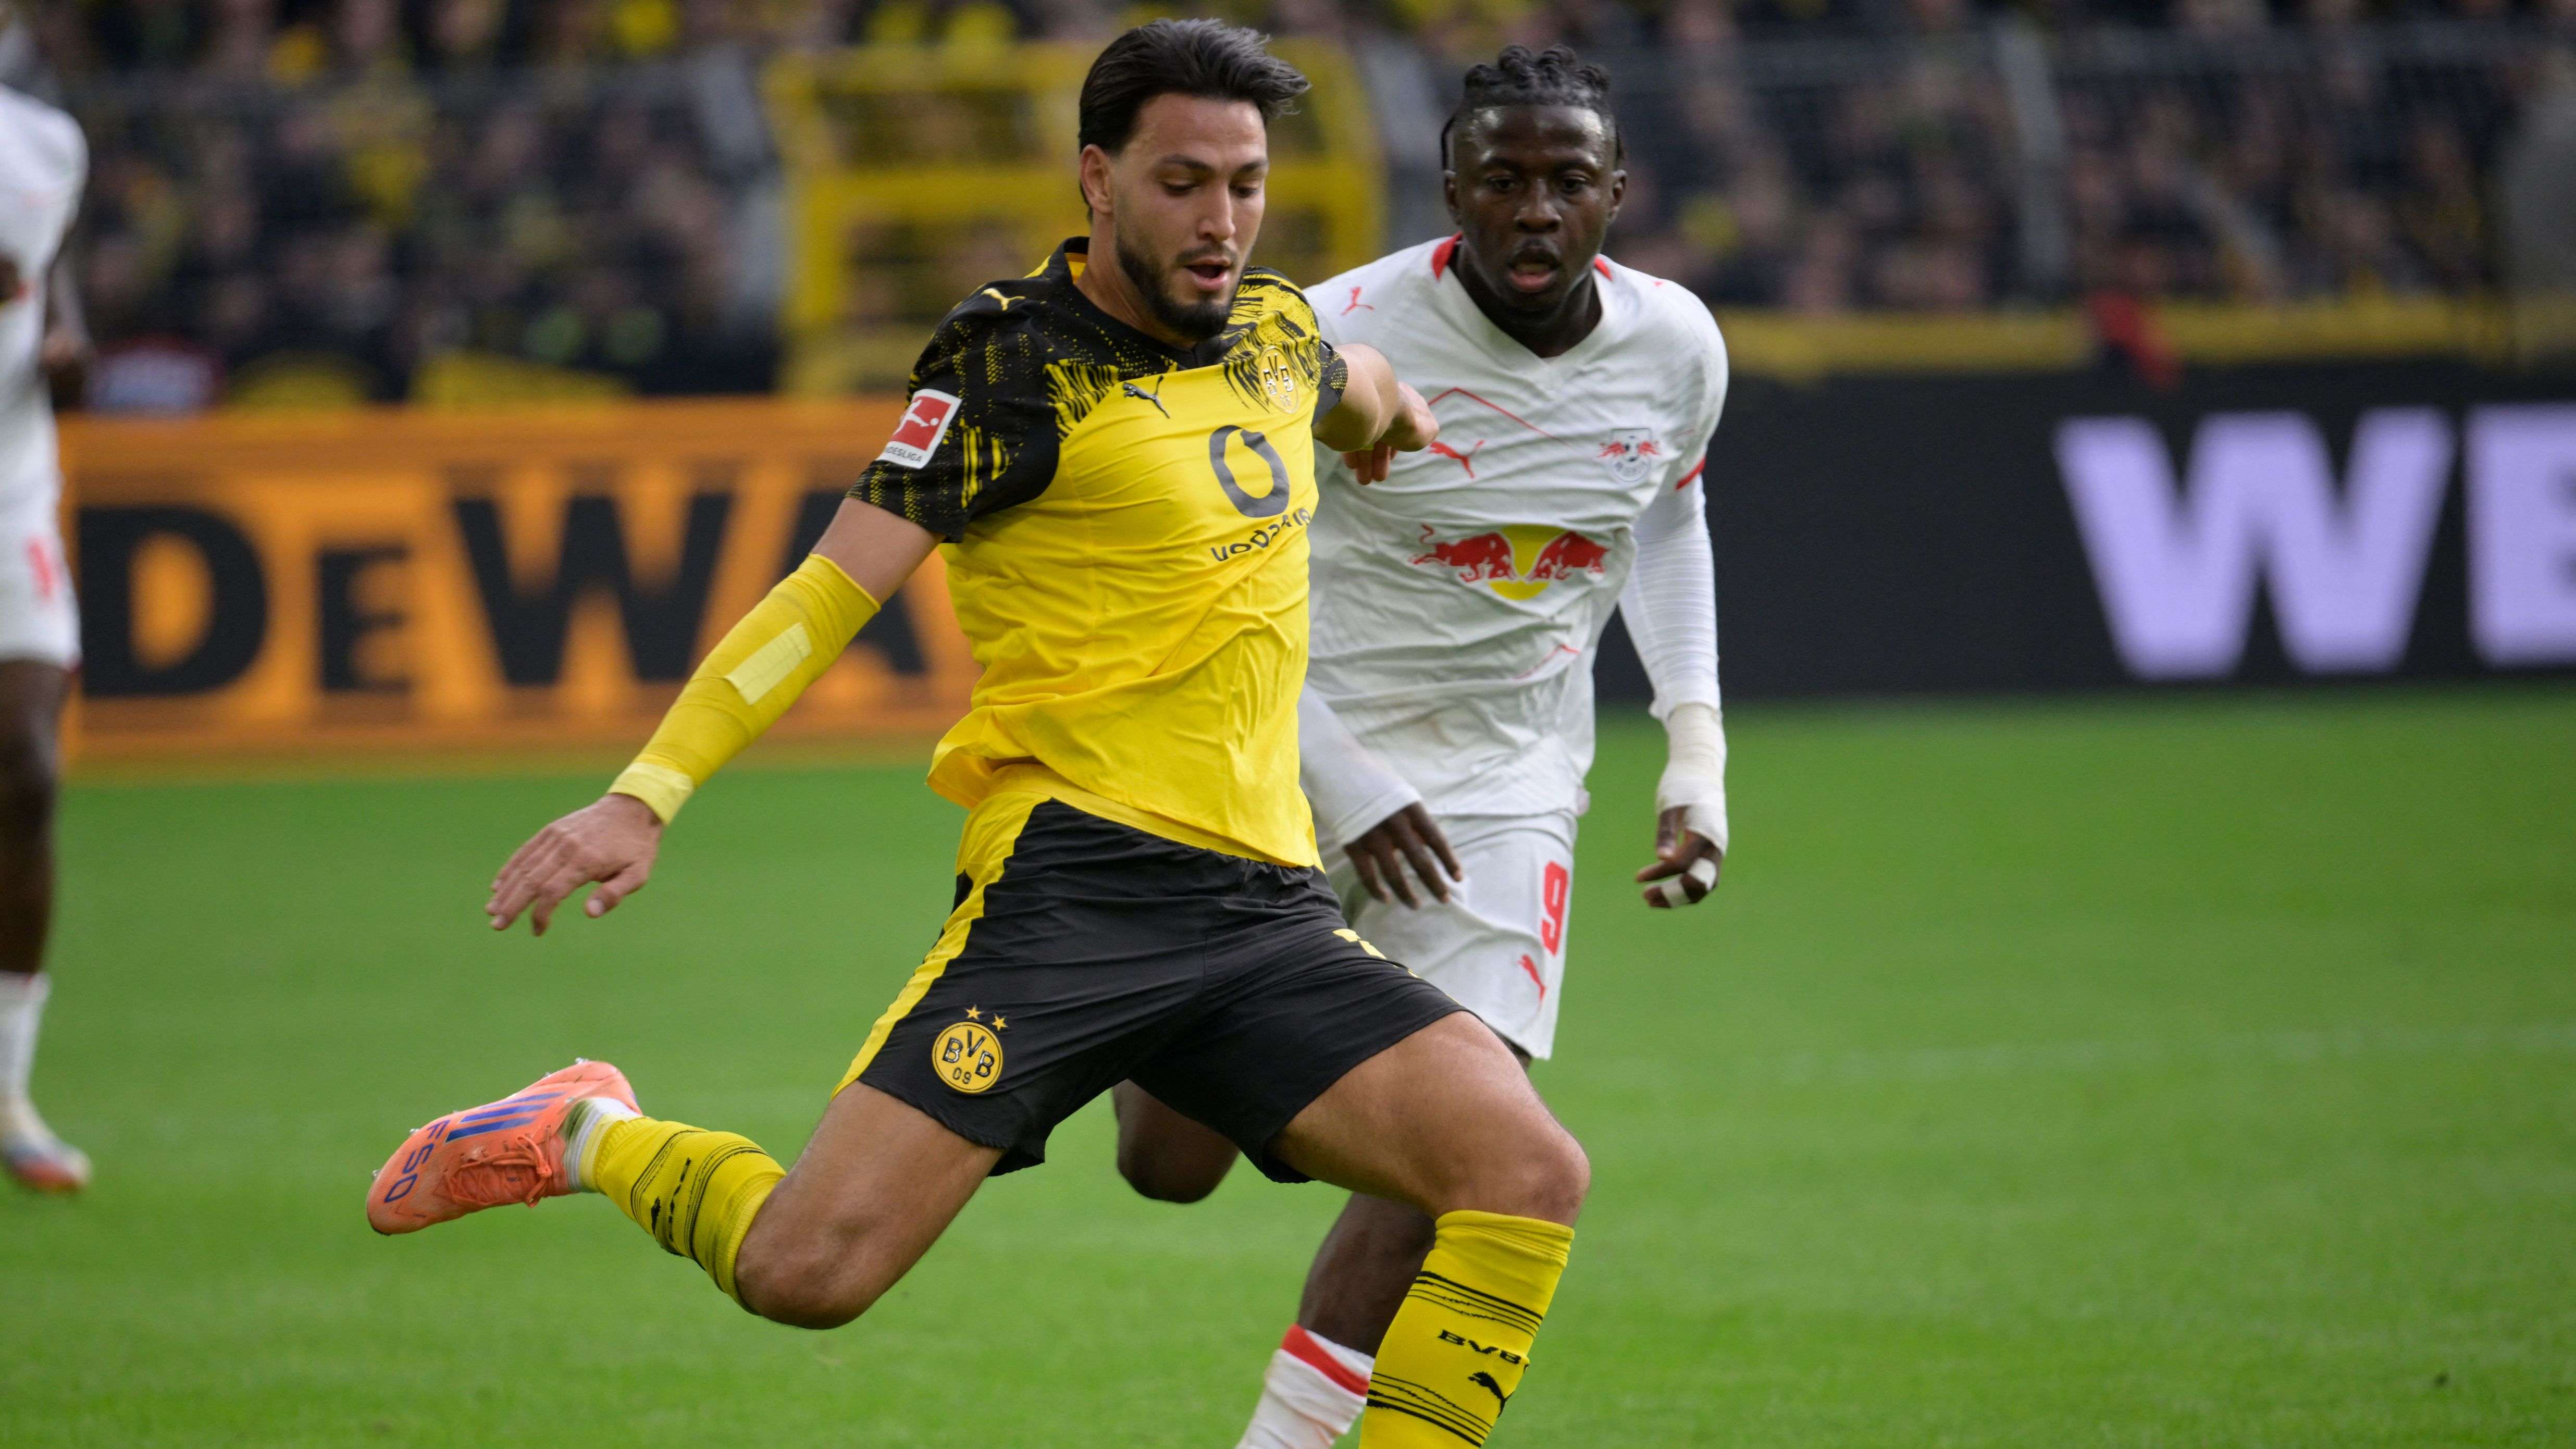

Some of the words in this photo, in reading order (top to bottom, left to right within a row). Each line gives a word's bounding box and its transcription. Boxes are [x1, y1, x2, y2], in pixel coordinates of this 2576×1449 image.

[885, 447, 922, 462] DESLIGA
[1541, 861, 1568, 957] 9
[942, 1029, 995, 1078] BVB
[952, 1067, 972, 1084] 09
[384, 1120, 451, 1203] F50
[1438, 1329, 1521, 1364] BVB
